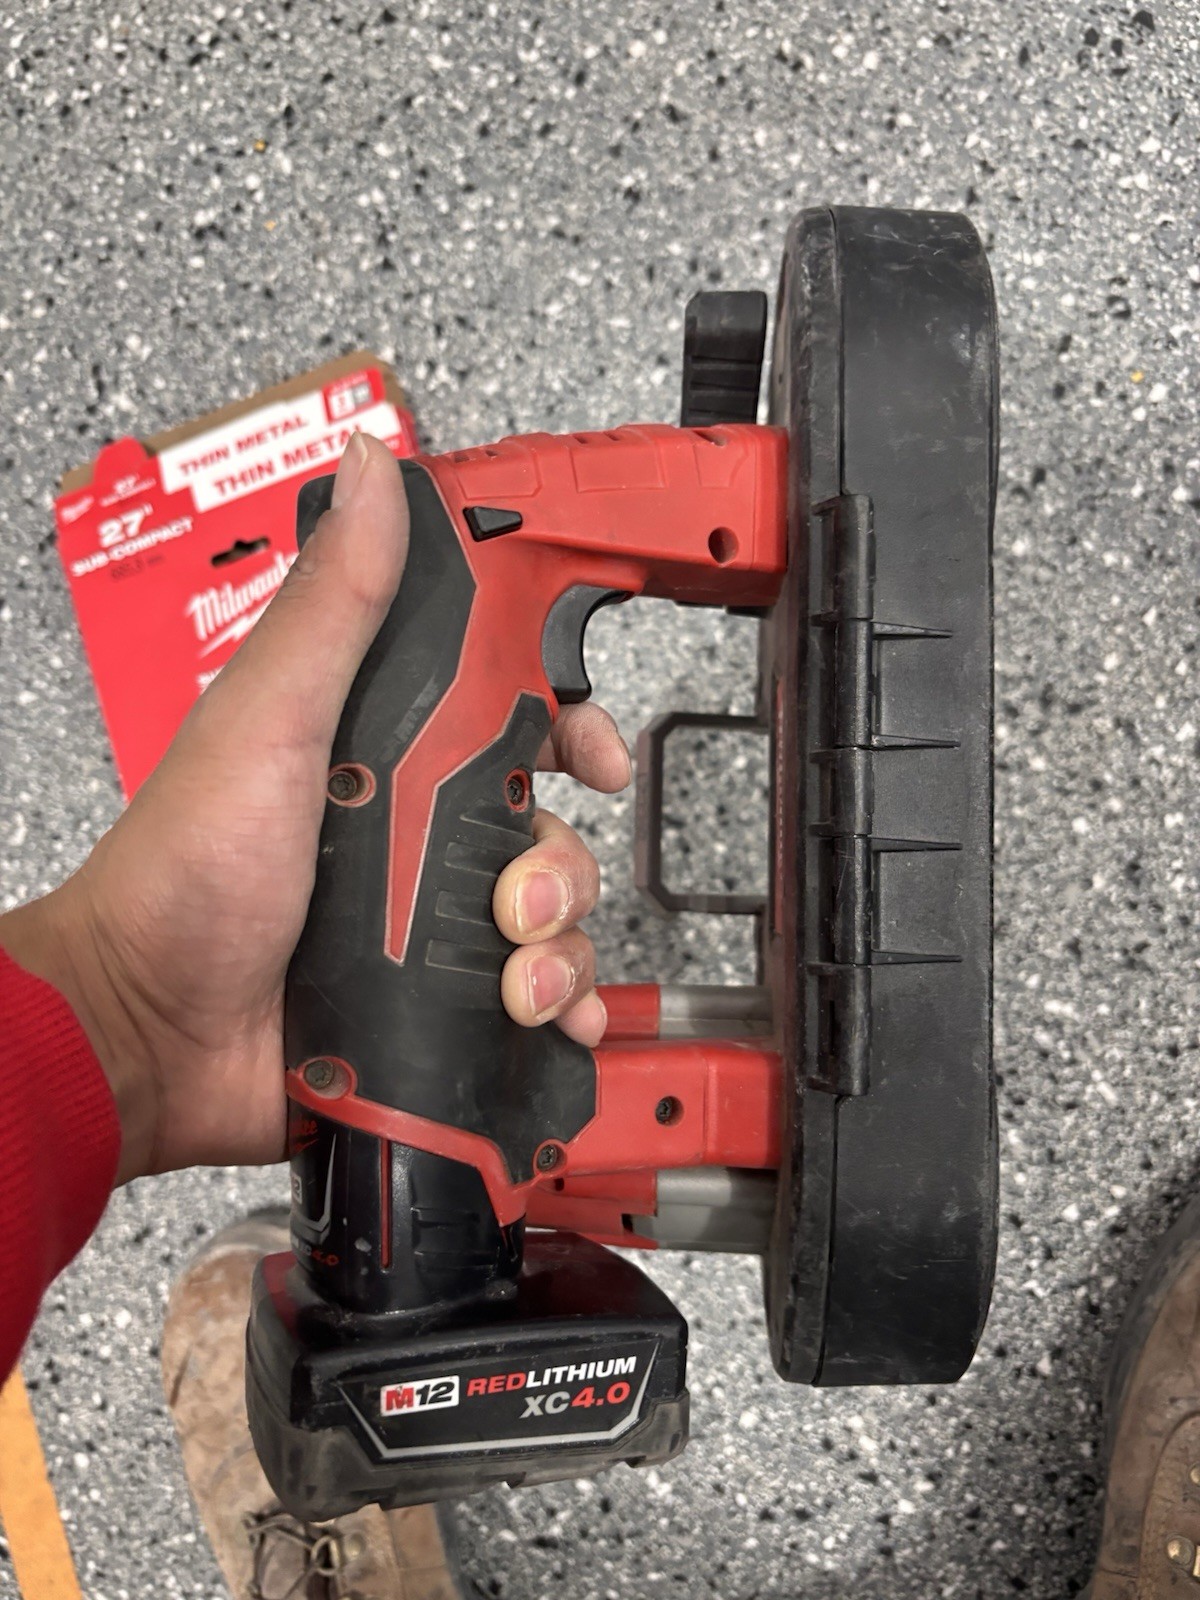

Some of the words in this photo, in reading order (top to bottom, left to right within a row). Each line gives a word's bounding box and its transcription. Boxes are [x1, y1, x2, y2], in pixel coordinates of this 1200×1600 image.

[178, 445, 231, 476] THIN
[235, 416, 309, 453] METAL
[213, 458, 276, 496] THIN
[281, 424, 361, 469] META
[71, 516, 193, 578] SUB-COMPACT
[384, 1380, 456, 1412] M12
[466, 1355, 638, 1397] REDLITHIUM
[519, 1381, 632, 1419] XC4.0
